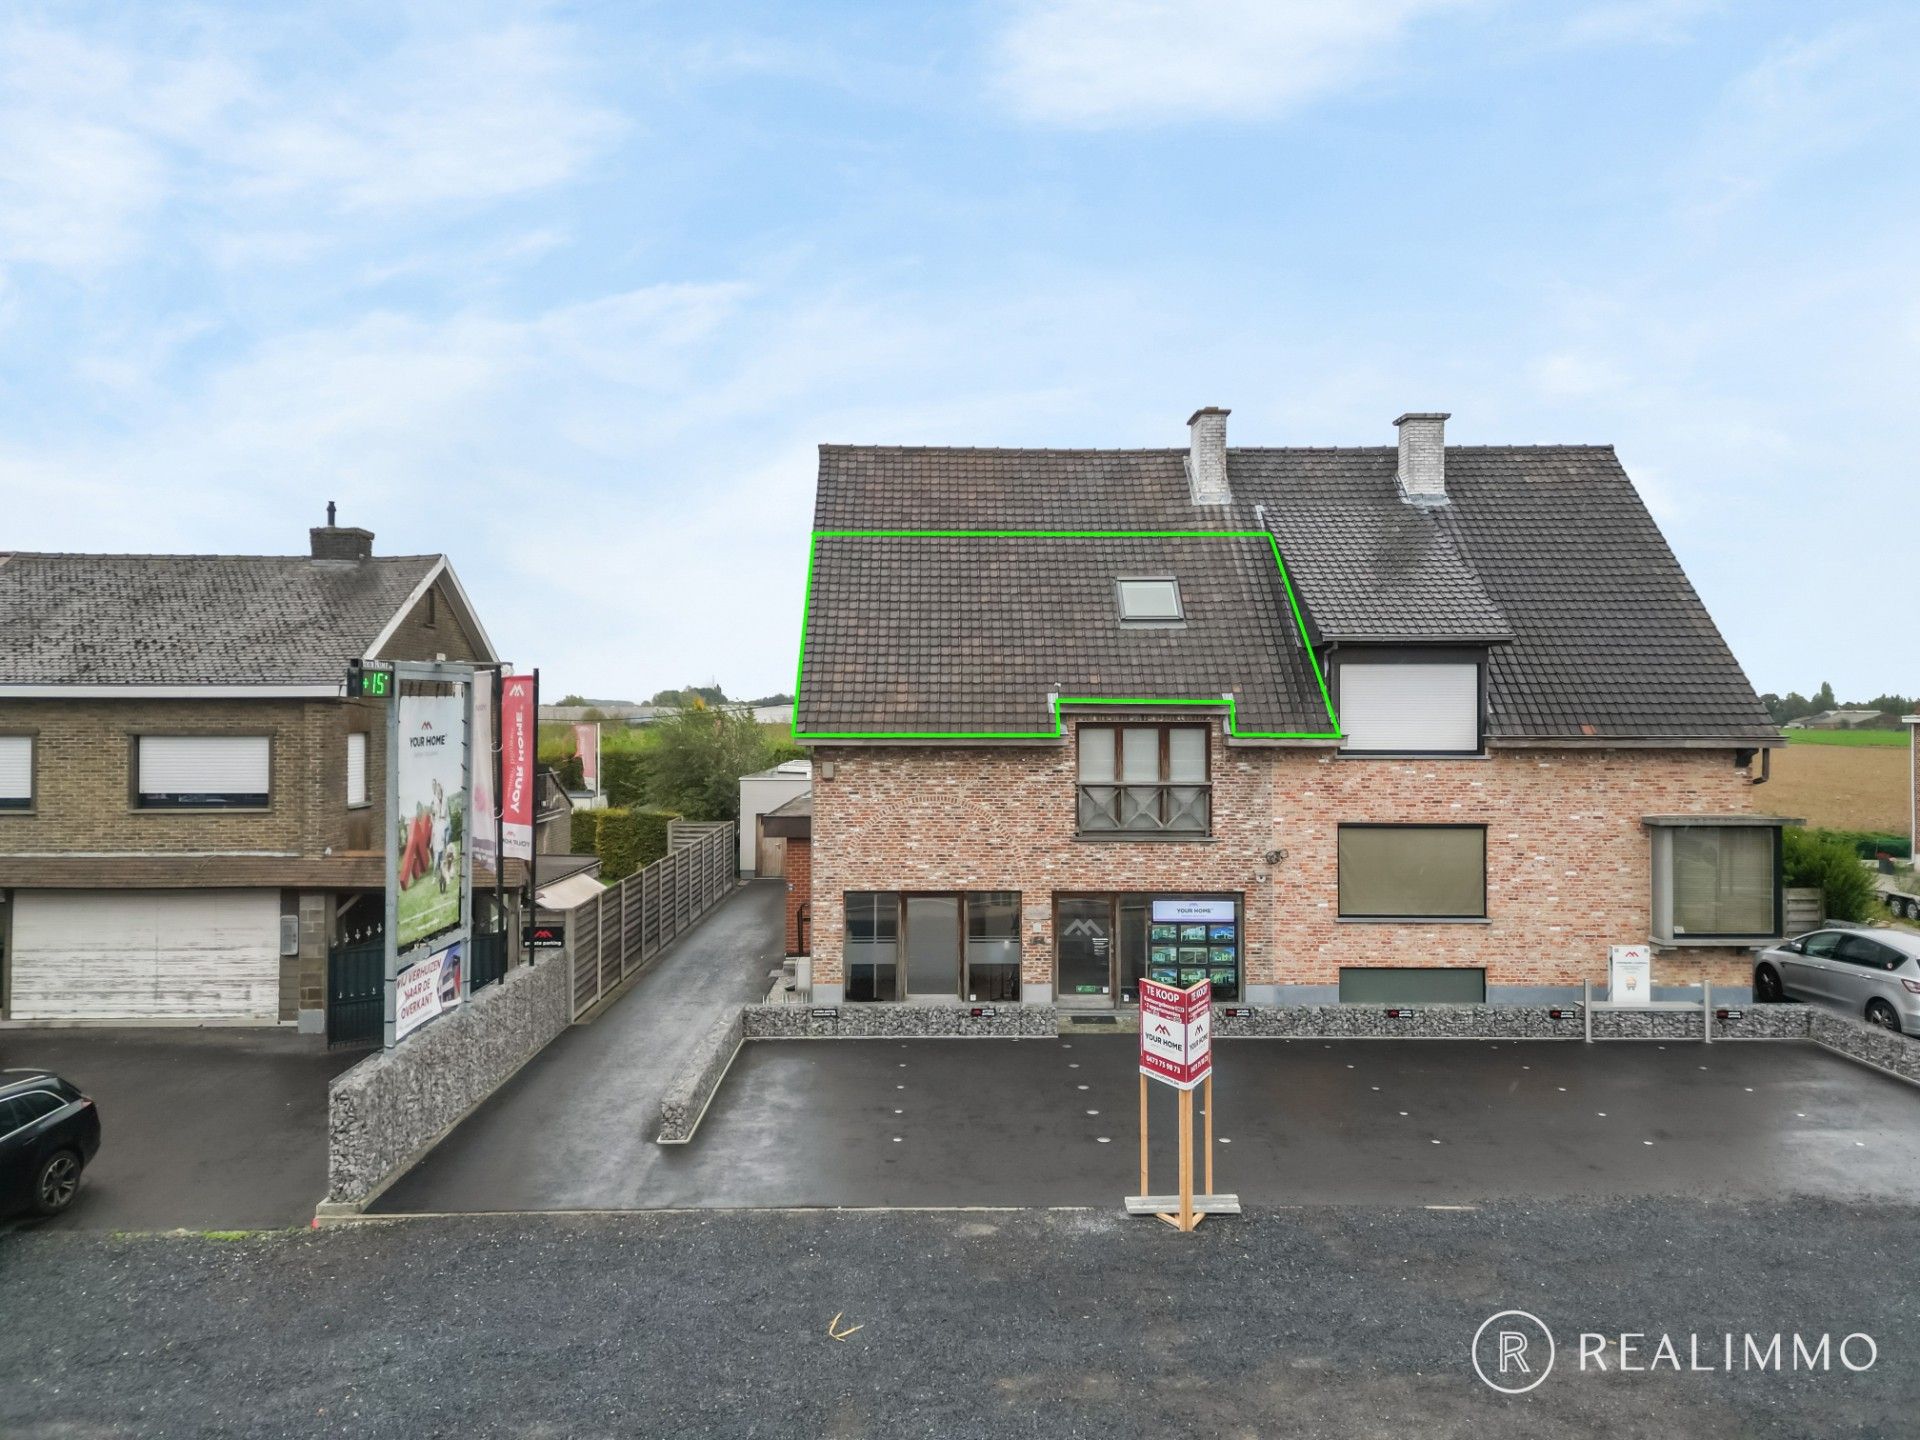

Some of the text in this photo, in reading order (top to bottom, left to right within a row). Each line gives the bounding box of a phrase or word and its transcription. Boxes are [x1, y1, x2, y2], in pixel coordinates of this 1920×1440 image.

[409, 735, 446, 748] YOUR HOME
[408, 958, 442, 983] VERHUIZEN
[404, 978, 431, 999] NAAR DE
[1146, 985, 1180, 1003] TE KOOP
[400, 993, 434, 1020] OVERKANT
[1146, 1032, 1161, 1045] YOUR
[1163, 1039, 1183, 1051] HOME
